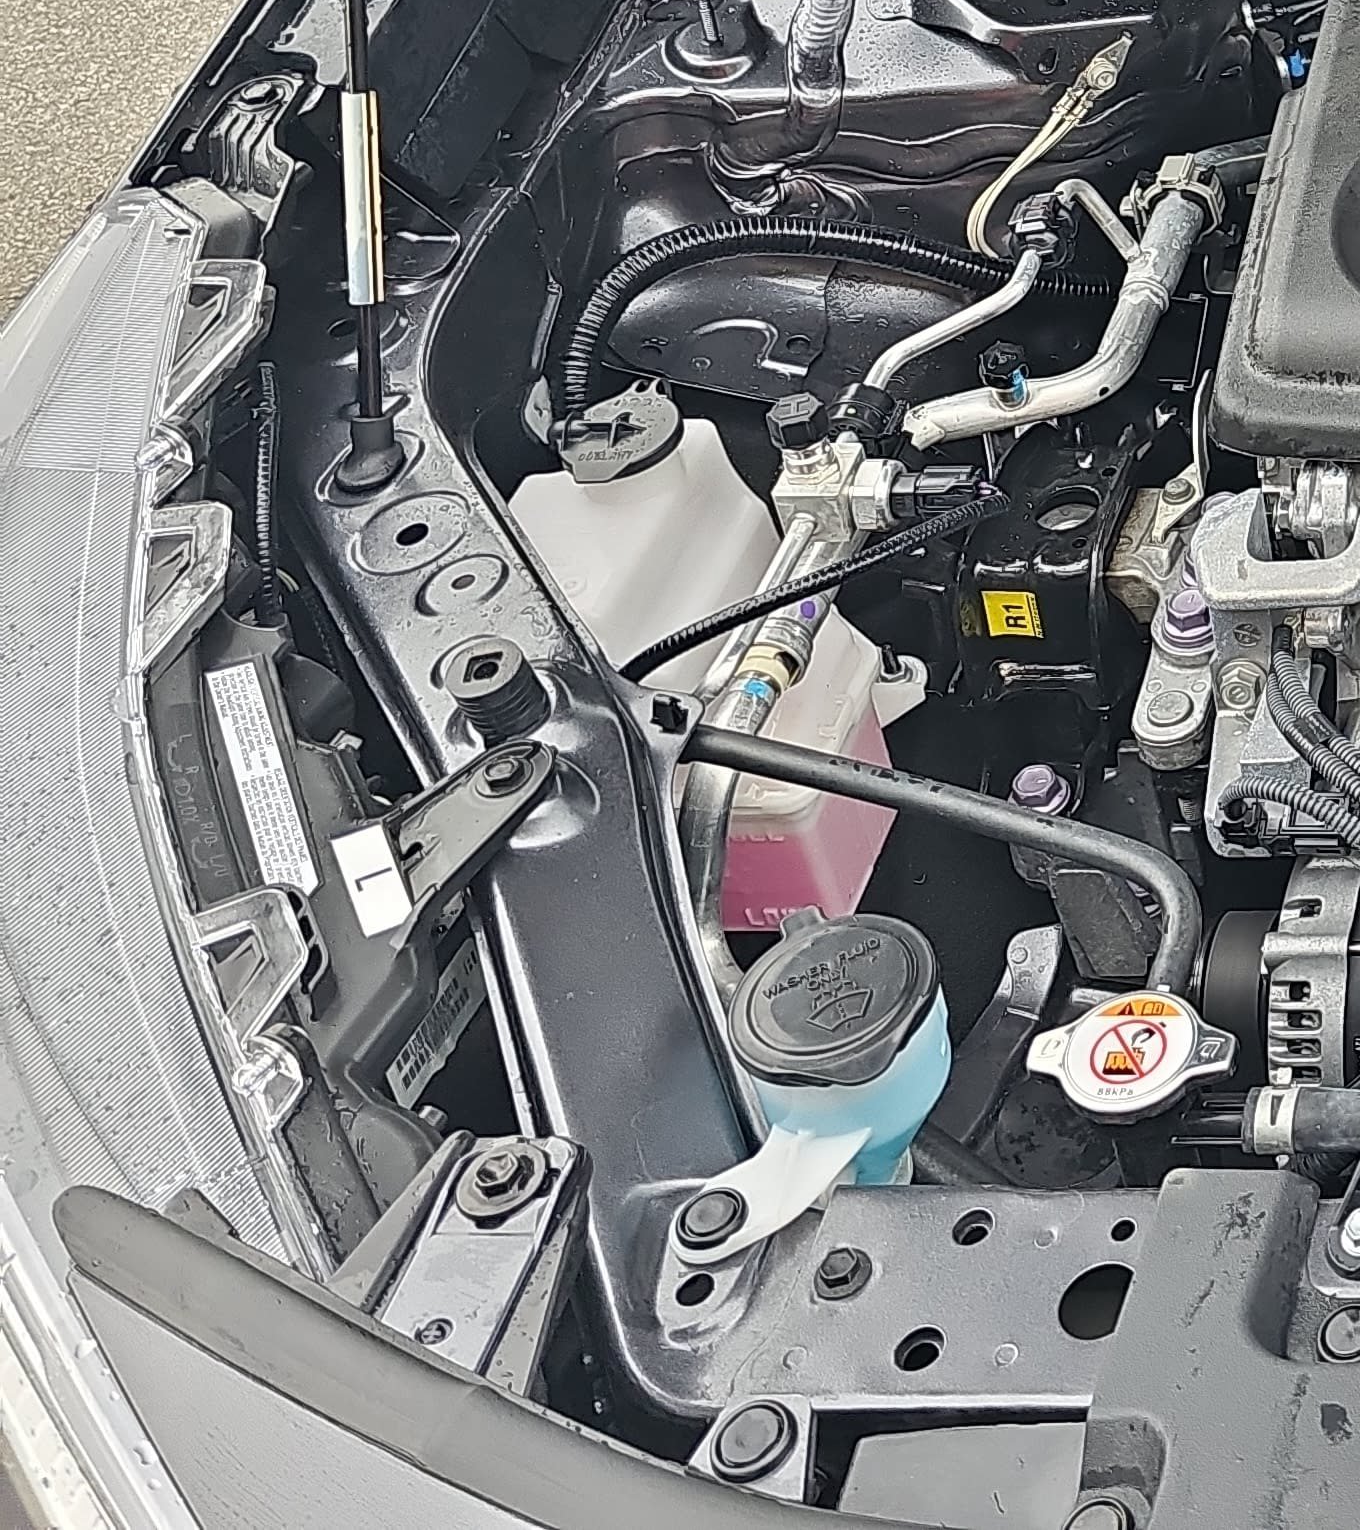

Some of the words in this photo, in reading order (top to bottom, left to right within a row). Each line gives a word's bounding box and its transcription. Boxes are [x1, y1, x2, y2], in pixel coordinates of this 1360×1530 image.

[1001, 604, 1028, 629] R1
[354, 866, 393, 893] L
[762, 962, 831, 1000] WASHER
[837, 937, 881, 967] FLUID
[1096, 1086, 1135, 1097] 88kPa
